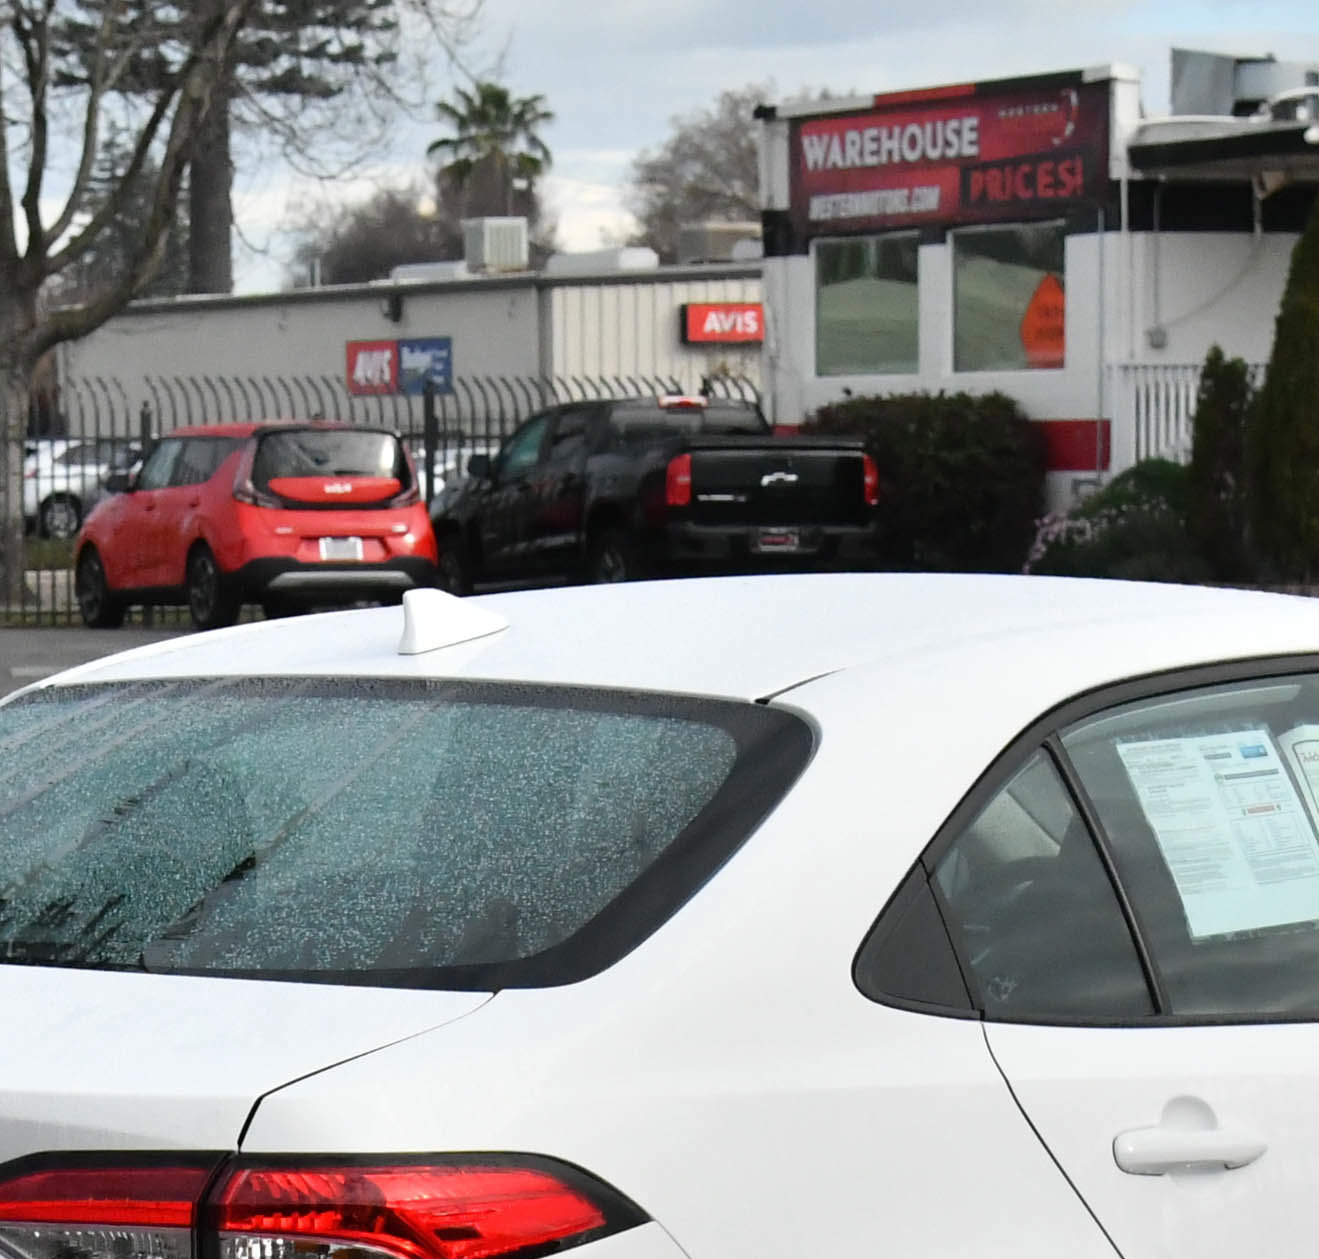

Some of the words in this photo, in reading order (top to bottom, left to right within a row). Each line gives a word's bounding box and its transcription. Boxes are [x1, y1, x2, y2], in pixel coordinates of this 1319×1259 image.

[802, 116, 979, 171] WAREHOUSE
[702, 309, 759, 335] AVIS
[353, 349, 393, 387] AVIS
